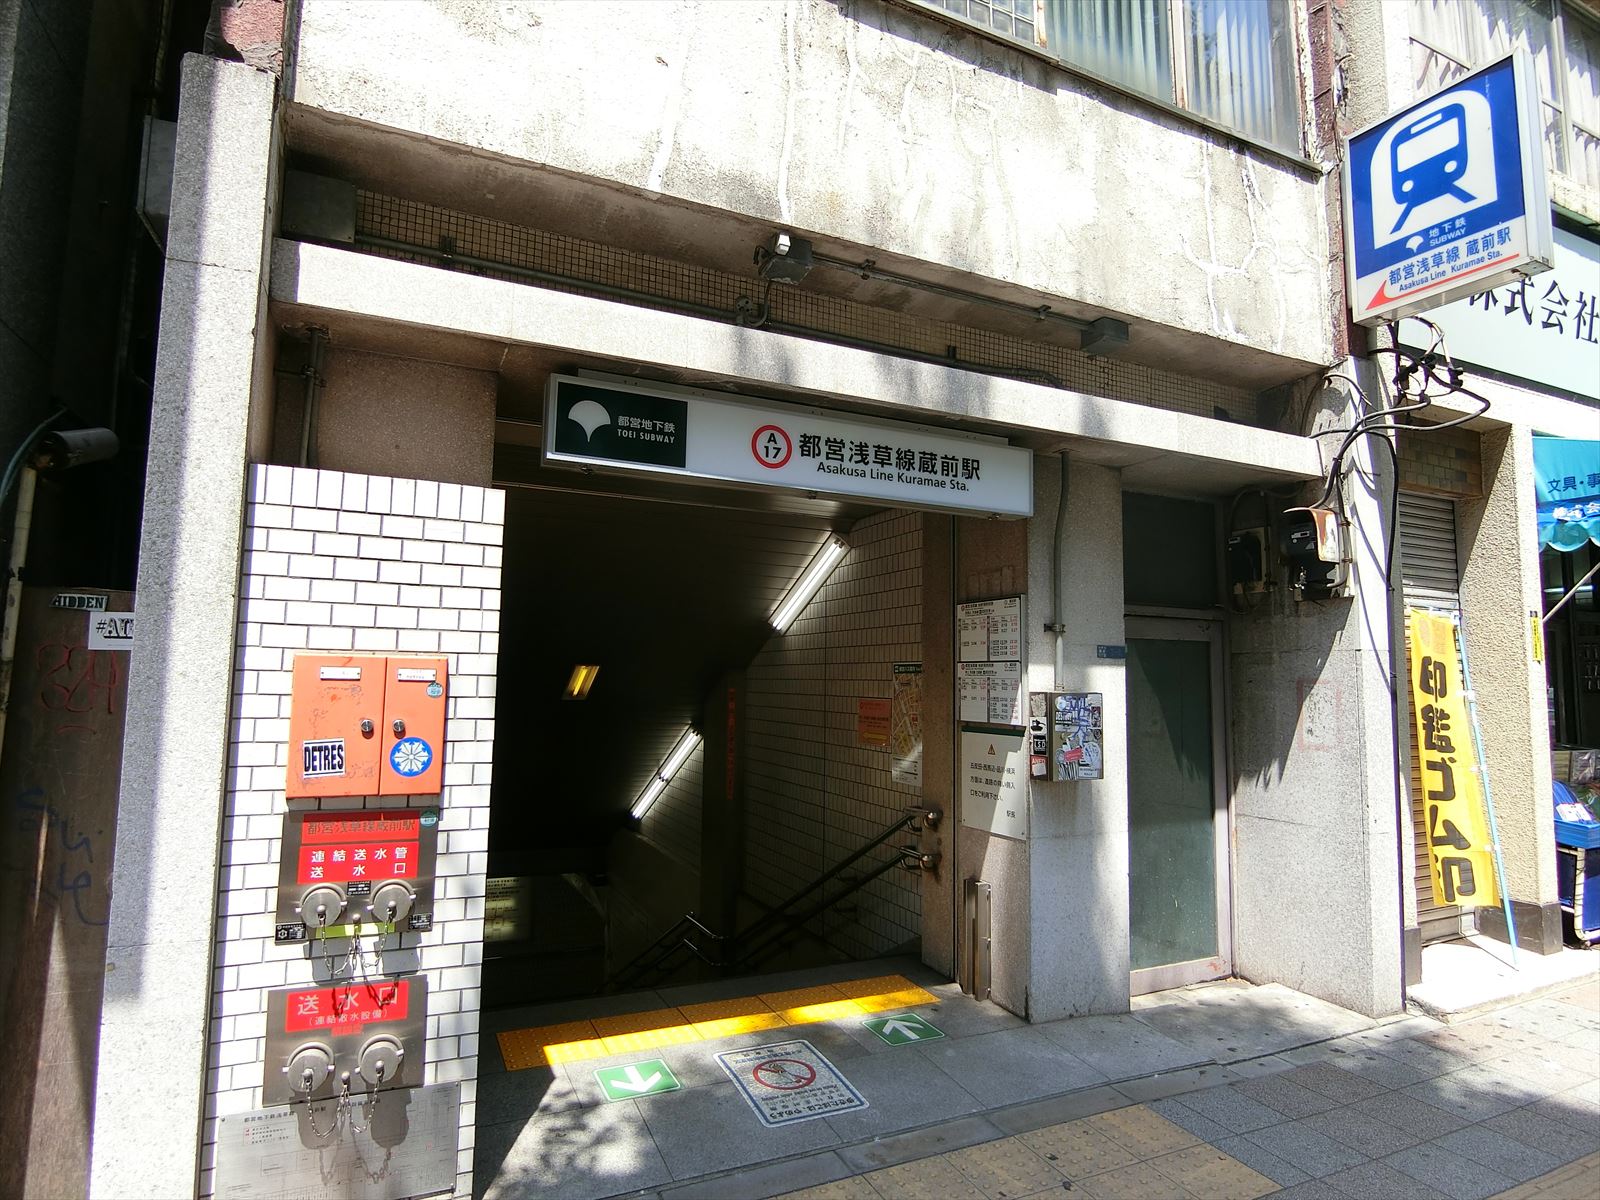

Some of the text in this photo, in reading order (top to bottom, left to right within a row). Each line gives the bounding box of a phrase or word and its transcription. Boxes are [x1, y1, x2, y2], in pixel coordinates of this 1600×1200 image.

[1429, 216, 1467, 238] 地下鉄
[1429, 228, 1466, 247] SUBWAY
[1388, 226, 1513, 286] 都営浅草線 蔵前駅
[1398, 250, 1504, 292] Asakusa Line Kuramae Sta.
[617, 415, 676, 434] 都営地下鉄
[617, 428, 675, 444] TOEI SUBWAY
[766, 433, 778, 445] A
[763, 445, 782, 459] 17
[798, 433, 981, 481] 都営浅草線蔵前駅
[816, 461, 969, 492] Asakusa Line Kuramae Sta.
[304, 744, 344, 772] DETRES
[311, 846, 408, 863] 連結送水管
[310, 862, 406, 879] 送水口
[297, 986, 398, 1015] 送水口
